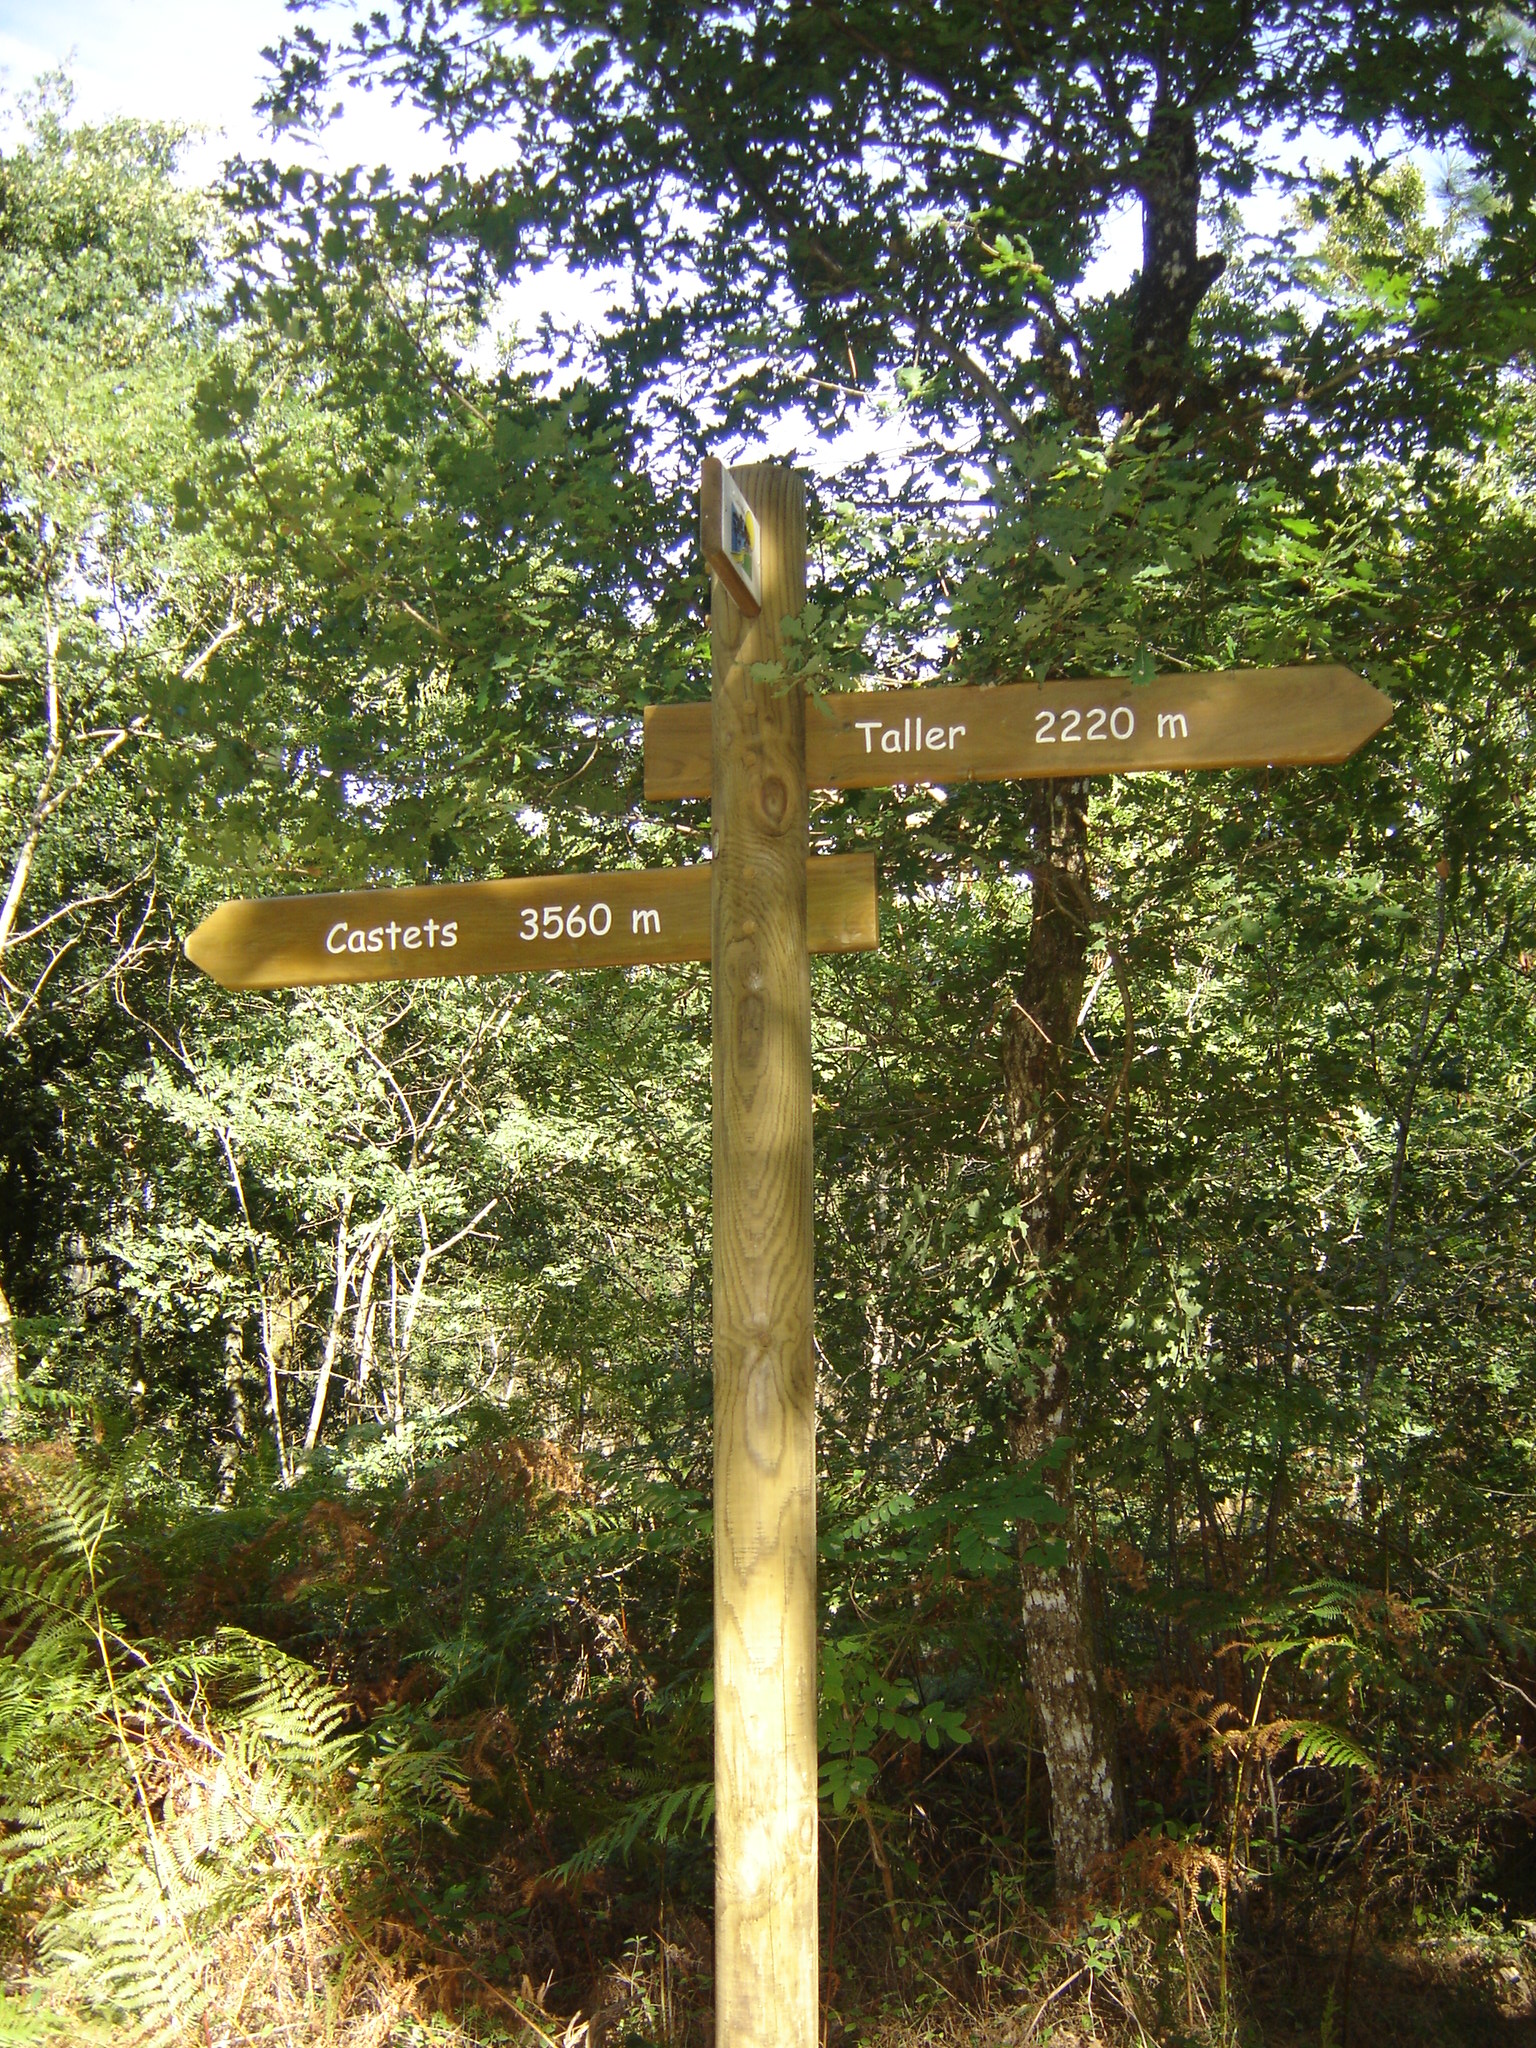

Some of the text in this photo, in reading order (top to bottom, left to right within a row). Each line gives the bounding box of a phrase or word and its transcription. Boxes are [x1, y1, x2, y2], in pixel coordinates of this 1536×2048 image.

[855, 706, 1188, 753] Taller 2220 m
[326, 903, 661, 954] Castets 3560 m
